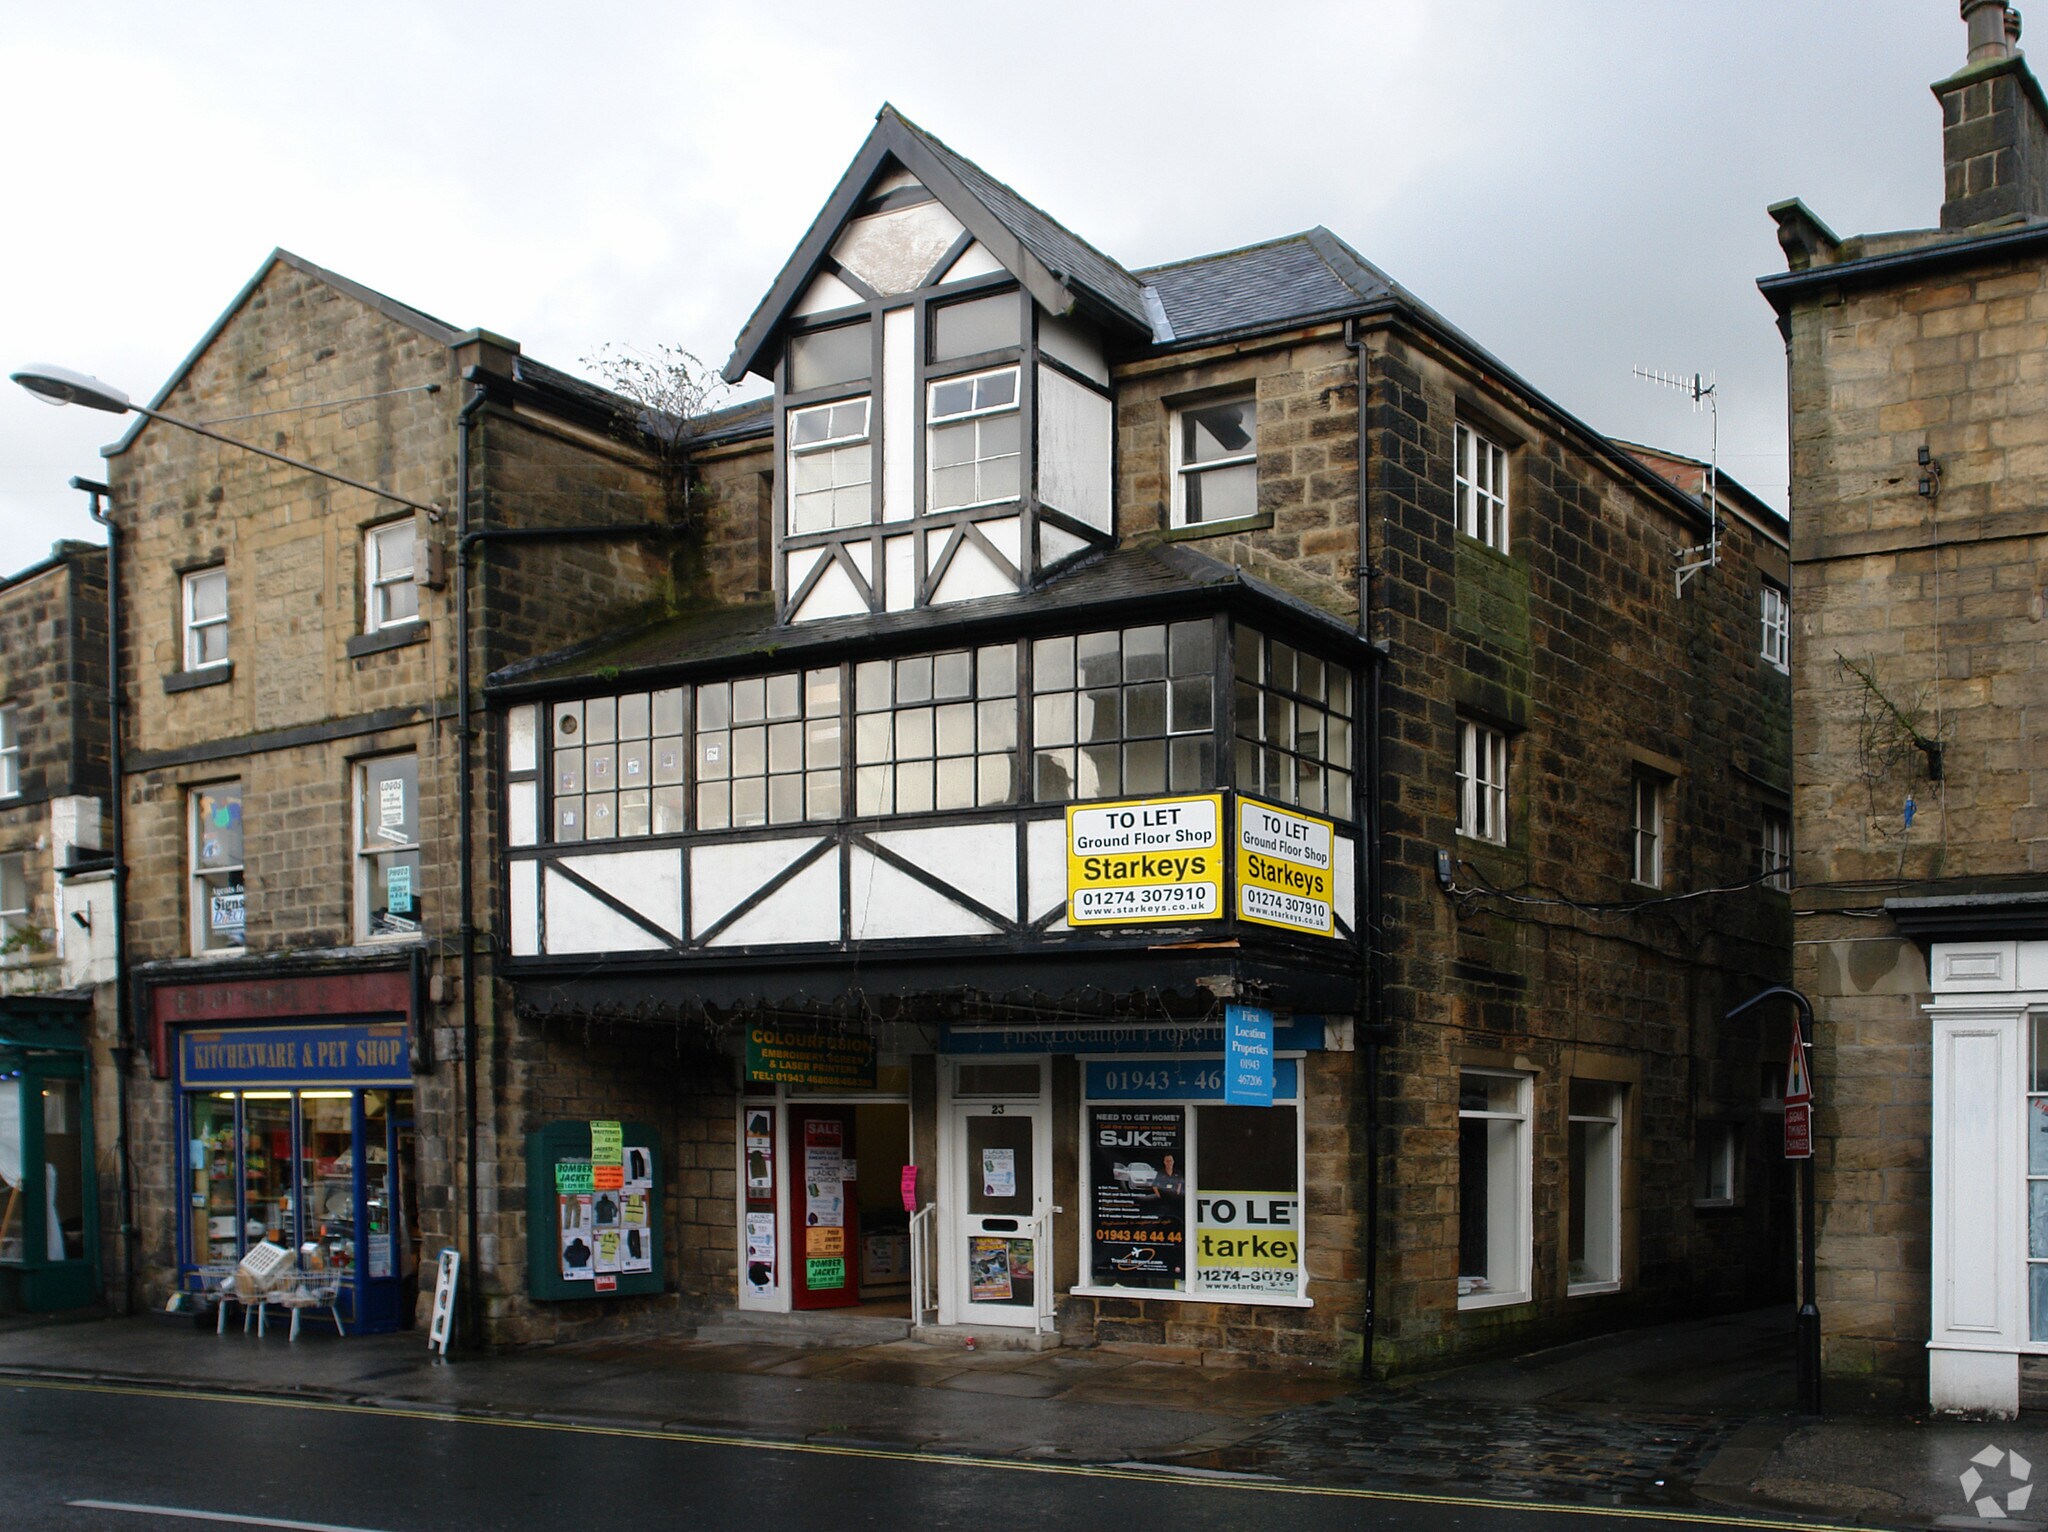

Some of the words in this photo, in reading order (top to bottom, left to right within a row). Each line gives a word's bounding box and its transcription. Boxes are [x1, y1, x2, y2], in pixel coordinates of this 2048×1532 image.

[1106, 813, 1135, 829] TO
[1144, 808, 1181, 827] LET
[1263, 815, 1281, 834] TO
[1286, 821, 1309, 841] LET
[1078, 834, 1129, 849] Ground
[1134, 832, 1170, 845] Floor
[1175, 829, 1212, 845] Shop
[1243, 831, 1276, 850] Ground
[1280, 841, 1302, 856] Floor
[1304, 847, 1327, 865] Shop
[1084, 855, 1206, 882] Starkeys
[1248, 855, 1324, 895] Starkeys
[1083, 891, 1135, 905] 01274
[1142, 887, 1206, 903] 307910
[214, 898, 244, 912] Signs
[1084, 902, 1205, 915] www.starkeys.co.uk
[1248, 890, 1282, 908] 01274
[1285, 898, 1324, 917] 307910
[1249, 906, 1324, 926] www.starkeys.co.uk
[1243, 1011, 1259, 1022] First
[1052, 1029, 1137, 1043] Location
[1235, 1025, 1266, 1039] Location
[752, 1029, 871, 1052] COLOURFUSION
[194, 1042, 296, 1069] KITCHENWARE
[303, 1041, 314, 1067] &
[318, 1041, 348, 1067] PET
[357, 1039, 401, 1066] SHOP
[1232, 1040, 1268, 1056] Properties
[828, 1054, 865, 1065] SCREEN
[1240, 1059, 1260, 1070] 01943
[769, 1059, 776, 1069] &
[779, 1060, 810, 1071] LASER
[813, 1063, 858, 1075] PRINTERS
[752, 1070, 774, 1081] TEL:
[776, 1072, 805, 1083] 01943
[1106, 1070, 1169, 1090] 01943
[1238, 1074, 1262, 1087] 467206
[992, 1105, 1004, 1114] 23
[1789, 1110, 1805, 1122] SIGNAL
[1152, 1114, 1180, 1122] HOME?
[808, 1123, 840, 1135] SALE
[1100, 1130, 1152, 1147] SJK
[558, 1165, 592, 1173] BOMBER
[560, 1174, 591, 1182] JACKET
[1197, 1200, 1236, 1224] TO
[1246, 1201, 1298, 1225] LE
[1096, 1229, 1131, 1240] 01943
[1132, 1230, 1147, 1241] 46
[1149, 1231, 1165, 1242] 44
[1167, 1232, 1183, 1243] 44
[1197, 1235, 1298, 1264] tarkey
[810, 1259, 841, 1268] BOMBER
[813, 1268, 840, 1277] JACKET
